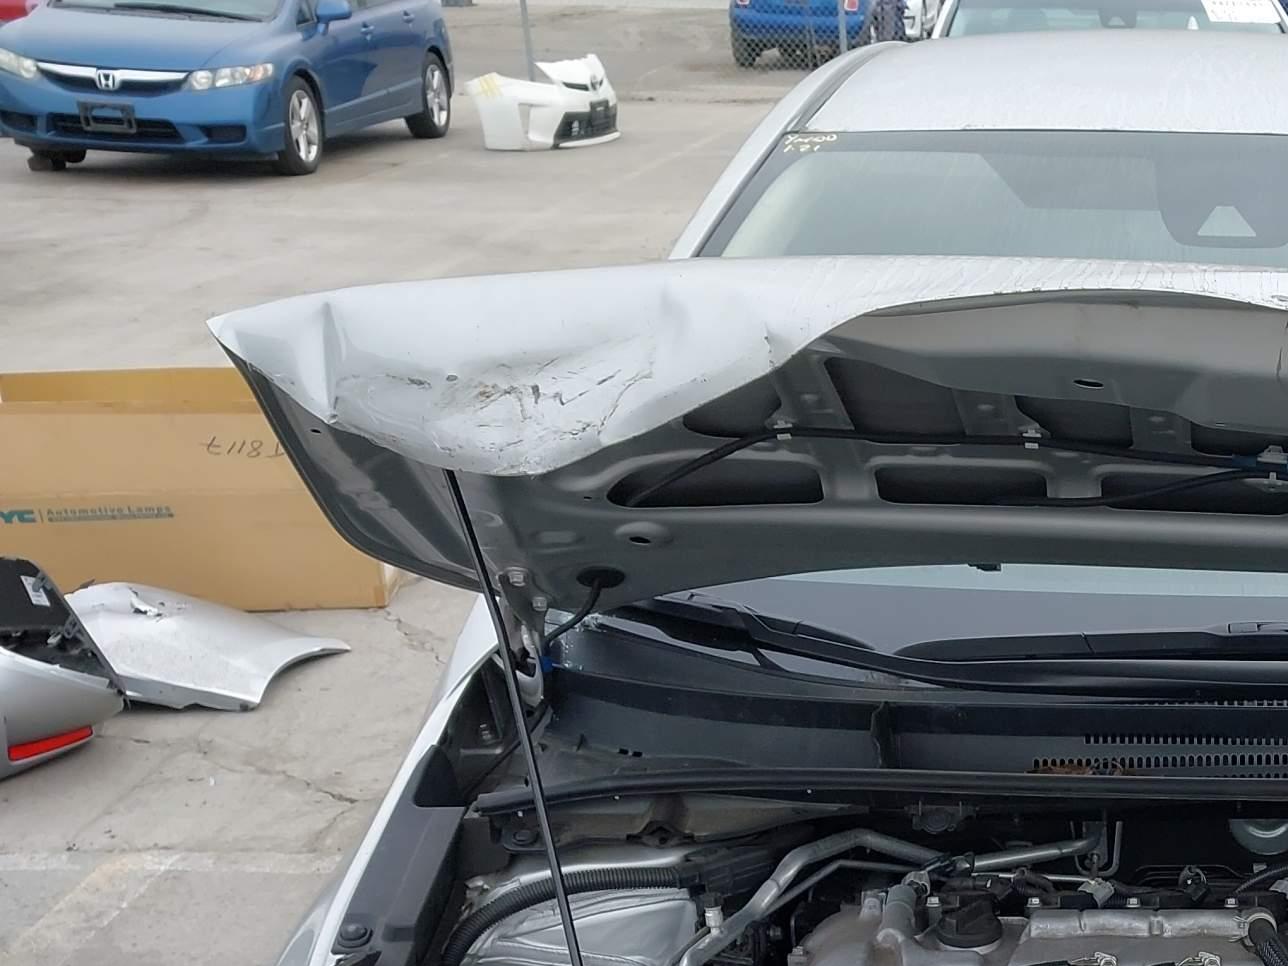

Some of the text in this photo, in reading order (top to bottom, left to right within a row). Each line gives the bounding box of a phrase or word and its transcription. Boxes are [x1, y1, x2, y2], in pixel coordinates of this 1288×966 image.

[0, 510, 37, 523] YC
[47, 506, 123, 516] Automotive
[128, 505, 172, 514] Lamps
